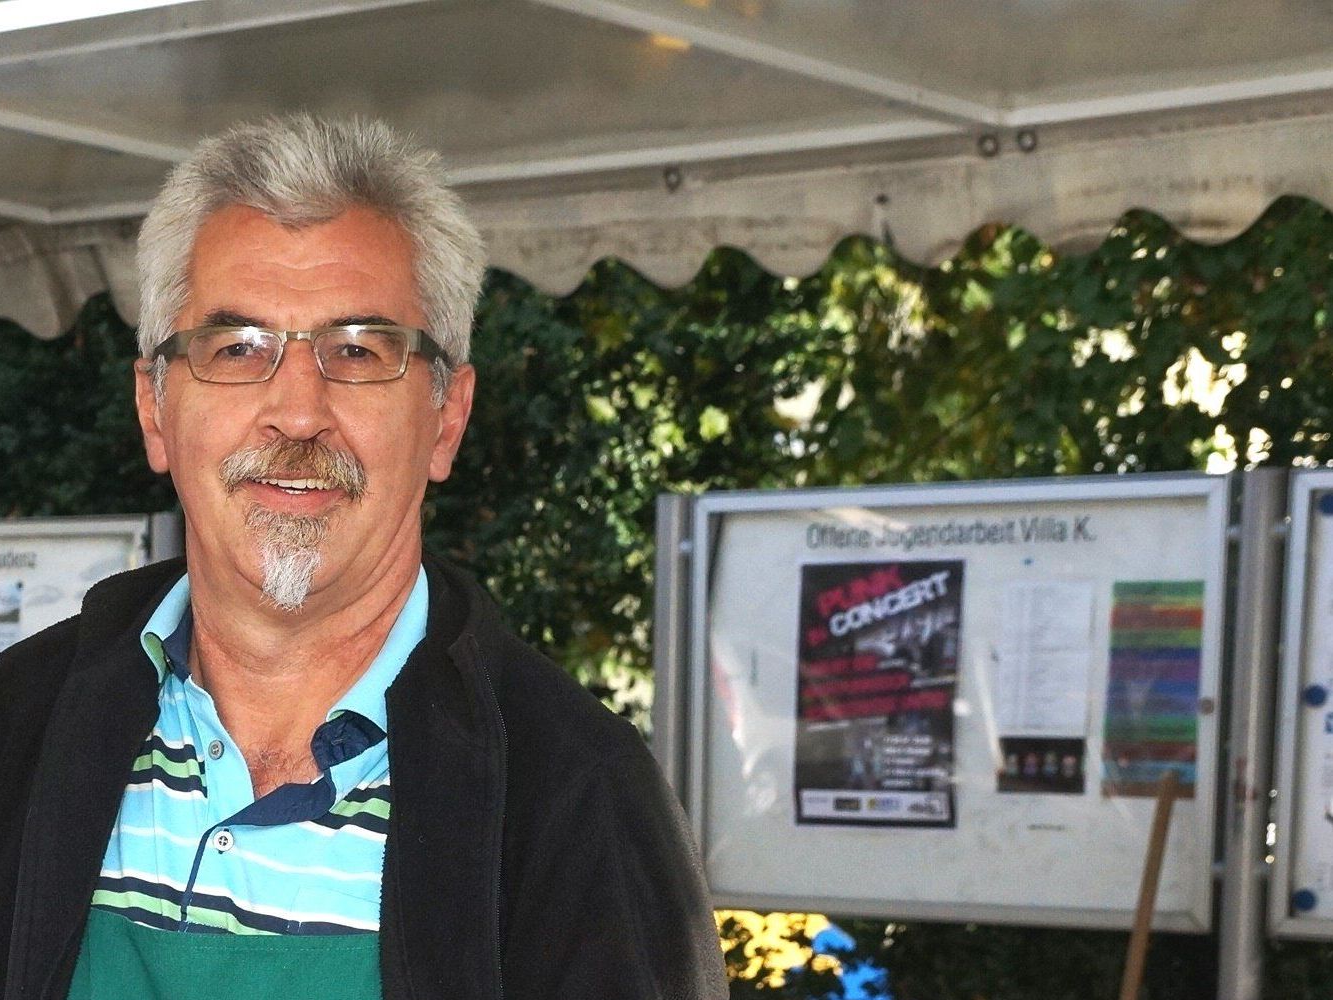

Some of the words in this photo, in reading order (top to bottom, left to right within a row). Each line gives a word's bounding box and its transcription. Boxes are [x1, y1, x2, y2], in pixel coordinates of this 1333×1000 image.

[806, 523, 869, 549] Offene
[873, 517, 1014, 552] Jugendarbeit
[1020, 516, 1067, 543] Villa
[1073, 516, 1098, 543] K.
[829, 569, 951, 638] CONCERT
